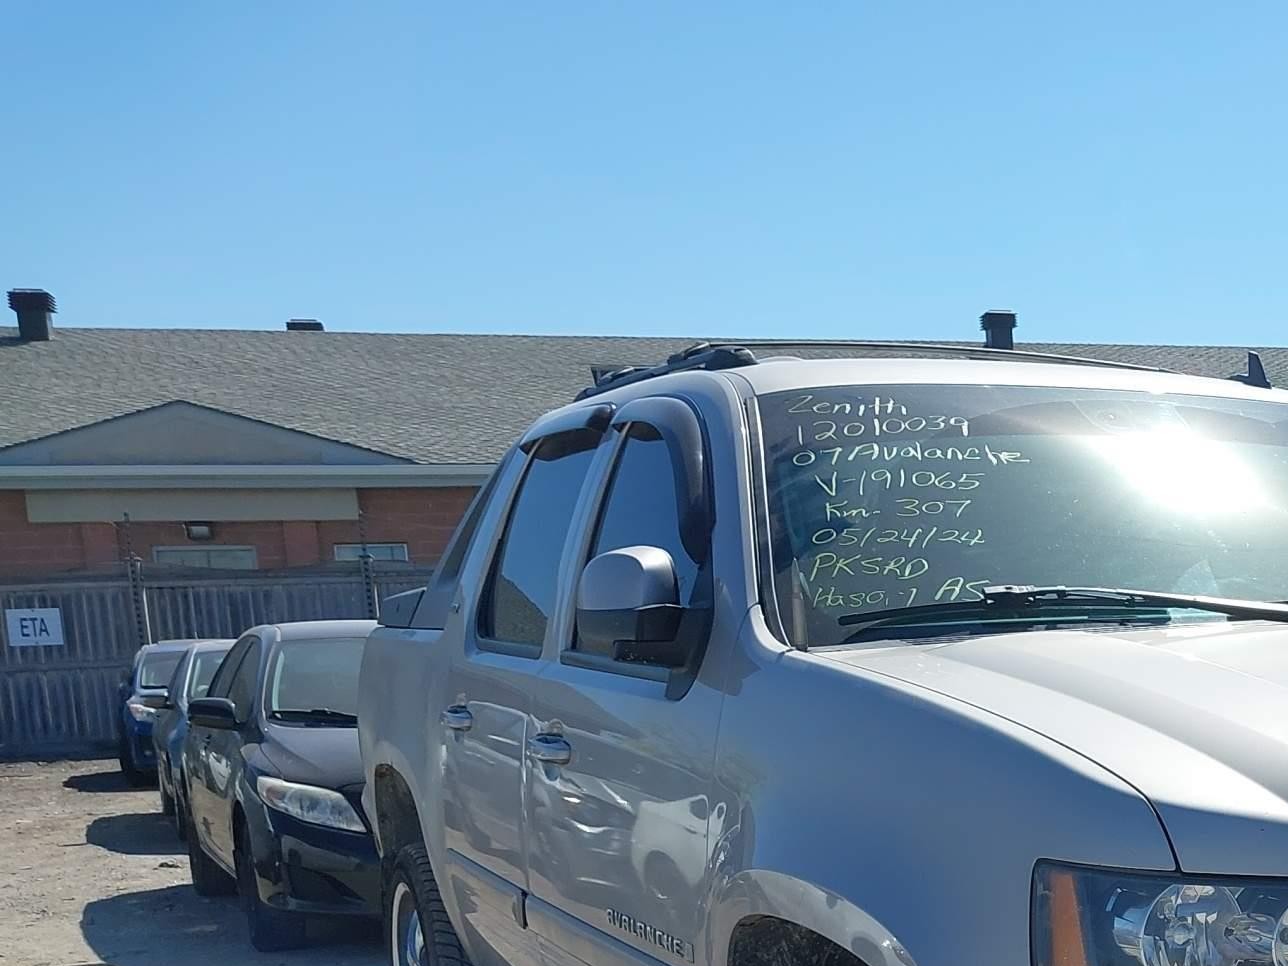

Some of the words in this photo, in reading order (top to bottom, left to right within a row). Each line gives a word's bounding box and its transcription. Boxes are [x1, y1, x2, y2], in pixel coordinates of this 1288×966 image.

[788, 395, 907, 416] Zenith
[798, 416, 969, 445] 12010039
[793, 447, 843, 466] 07
[848, 441, 1031, 466] Avalanche
[814, 469, 986, 496] V-191065
[896, 498, 972, 518] 307
[812, 527, 985, 549] 05/24/24
[810, 552, 929, 582] PKSRD
[20, 617, 50, 638] ETA
[606, 907, 684, 958] AVALANCHE
